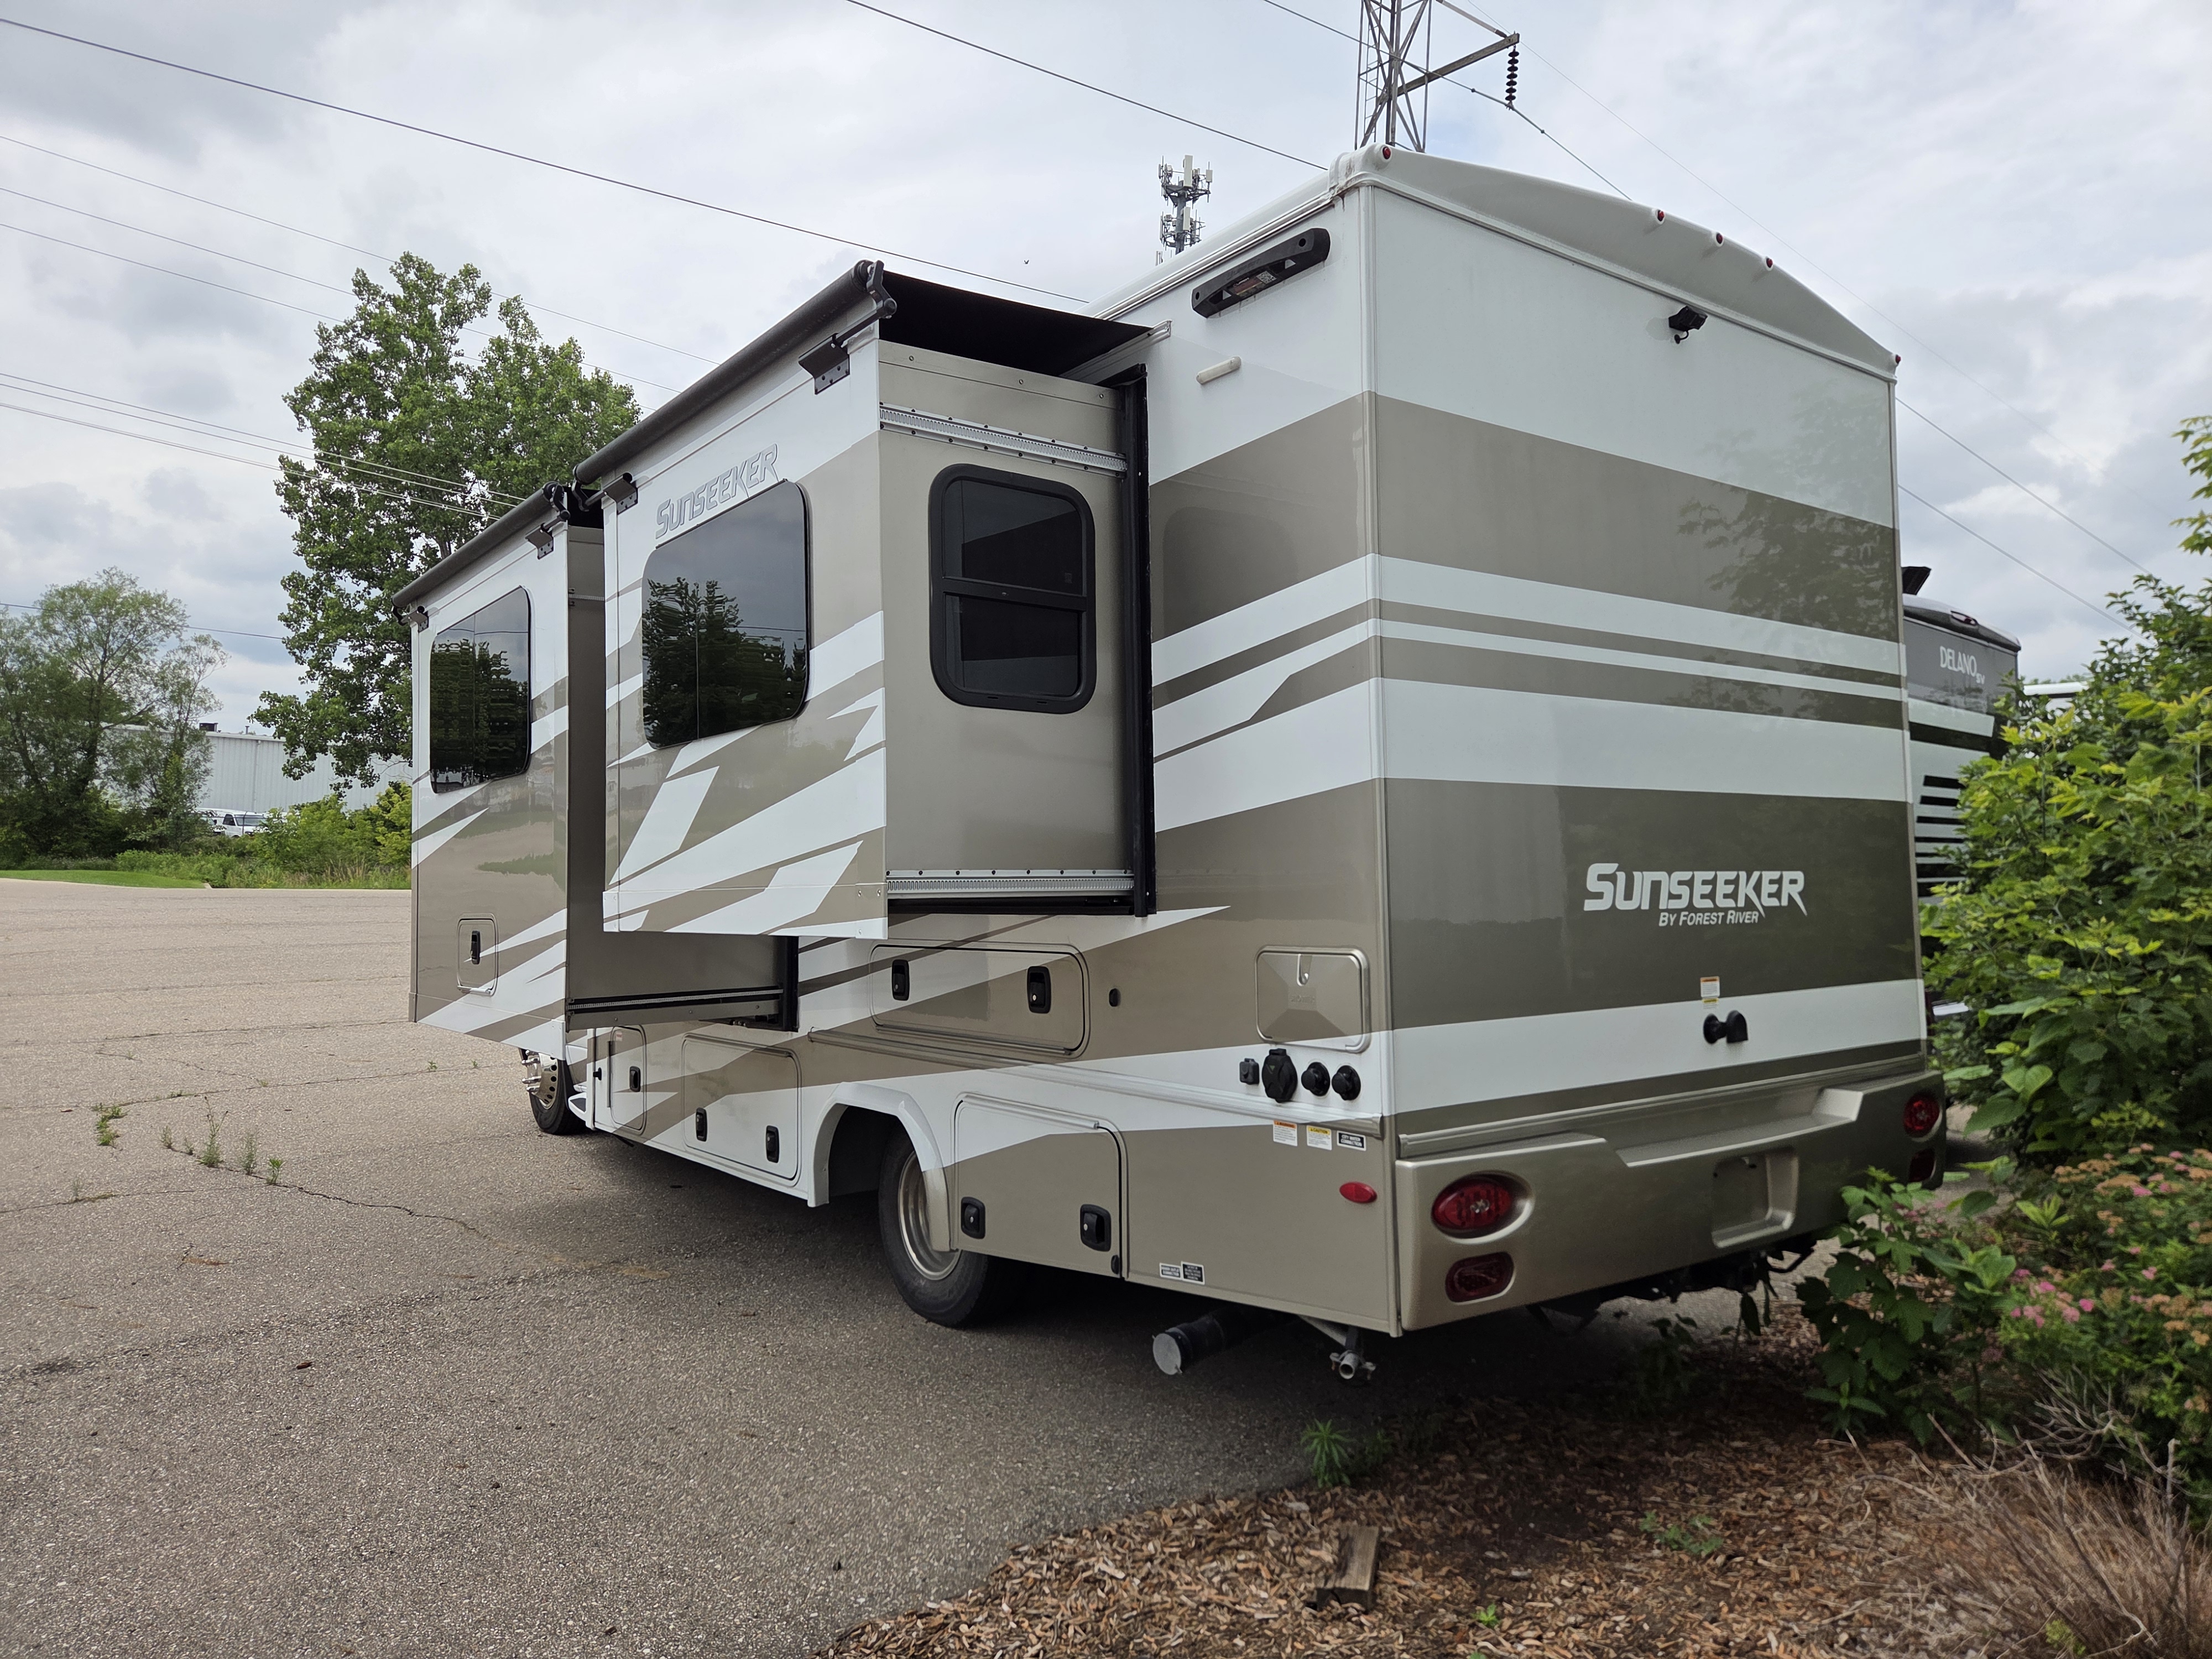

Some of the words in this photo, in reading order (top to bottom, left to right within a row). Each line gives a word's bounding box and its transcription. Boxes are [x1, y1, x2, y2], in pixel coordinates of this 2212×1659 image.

[655, 444, 779, 539] SUNSEEKER
[1940, 645, 1977, 677] DELANO
[1583, 863, 1807, 917] SUNSEEKER
[1658, 912, 1677, 927] BY
[1679, 911, 1725, 926] FOREST
[1726, 910, 1759, 925] RIVER
